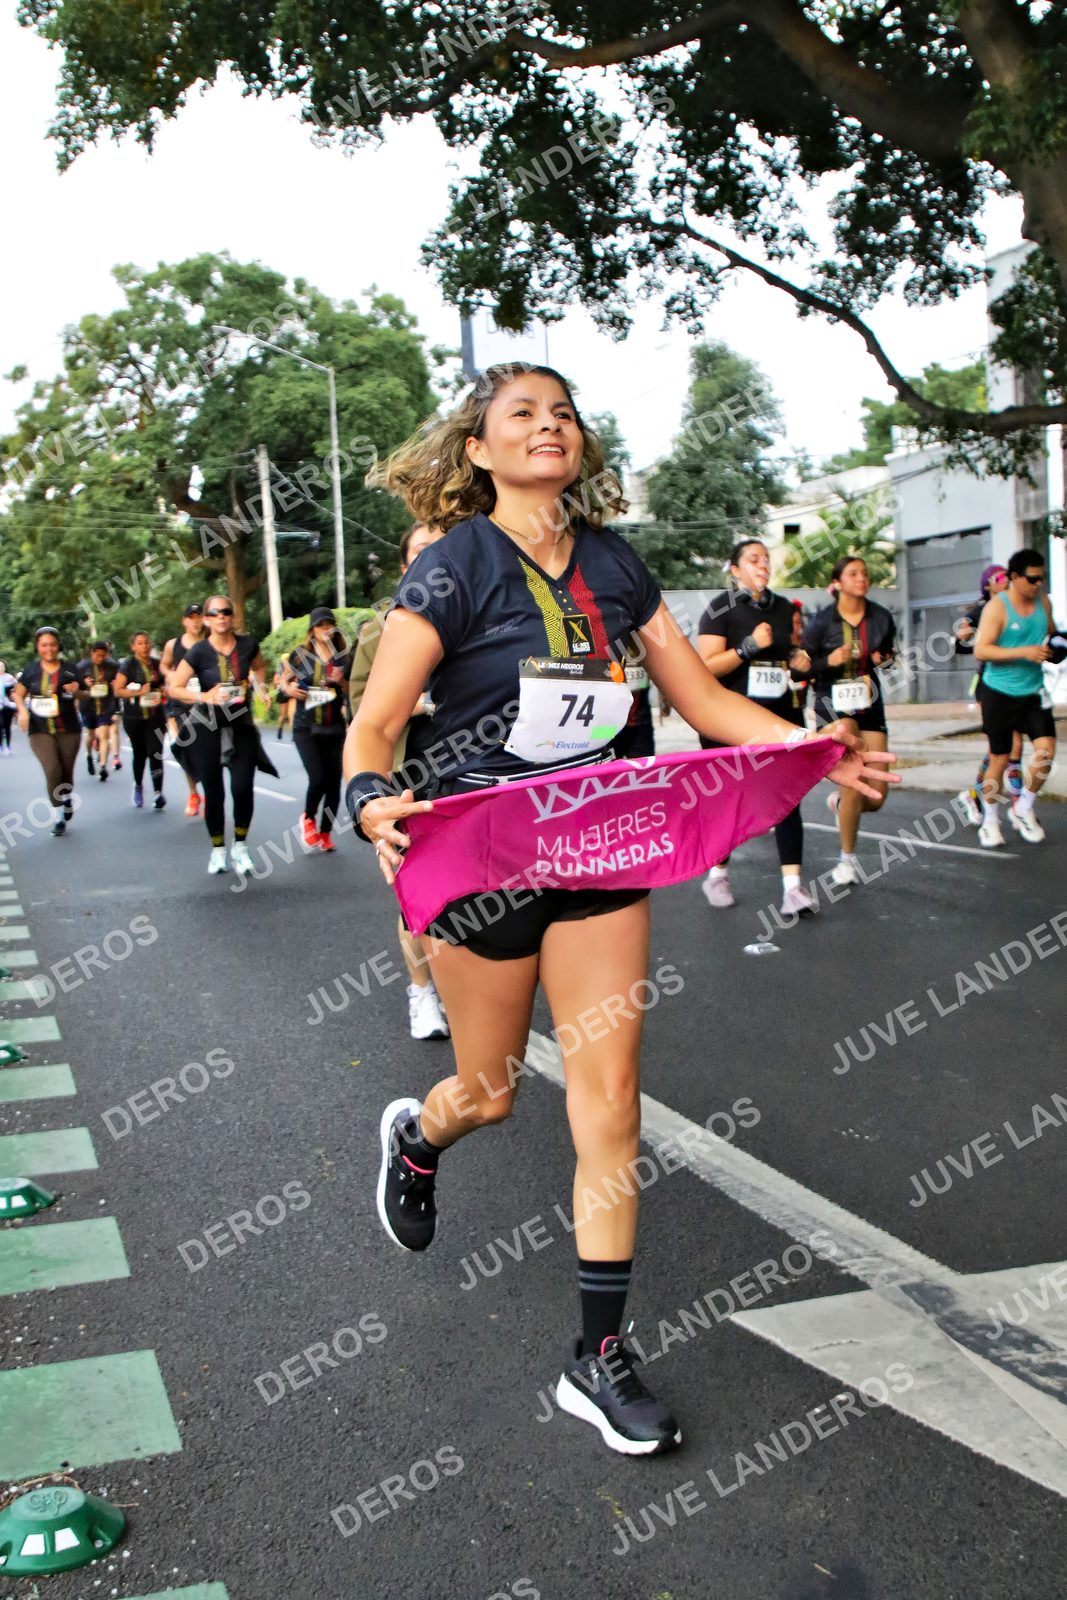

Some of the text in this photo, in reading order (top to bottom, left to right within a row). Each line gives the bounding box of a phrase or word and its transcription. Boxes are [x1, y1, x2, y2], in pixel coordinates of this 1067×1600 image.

[756, 671, 782, 684] 7180
[558, 694, 595, 727] 74
[537, 802, 667, 857] MUJERES
[536, 833, 674, 877] RUNNERAS
